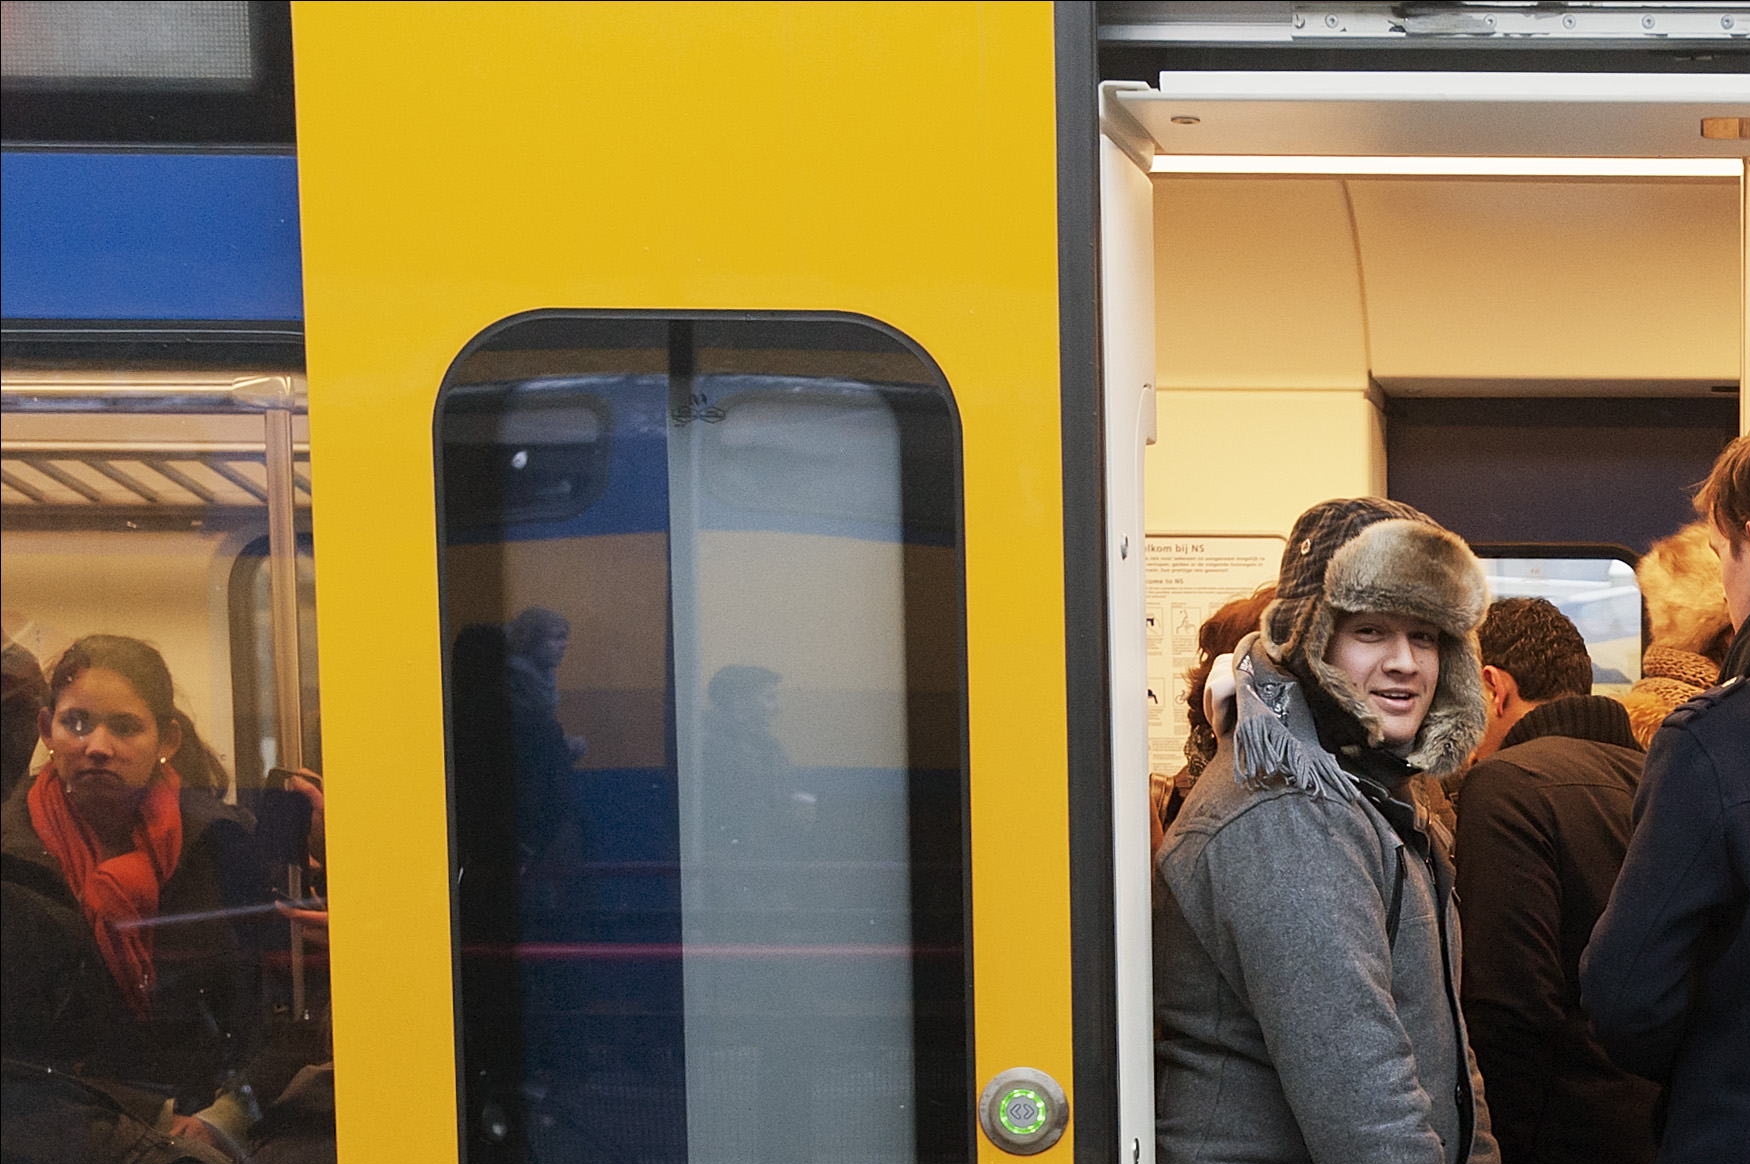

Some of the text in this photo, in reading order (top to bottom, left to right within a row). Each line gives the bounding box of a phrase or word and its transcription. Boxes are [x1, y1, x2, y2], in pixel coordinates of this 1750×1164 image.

[1145, 544, 1205, 554] lkom bij NS
